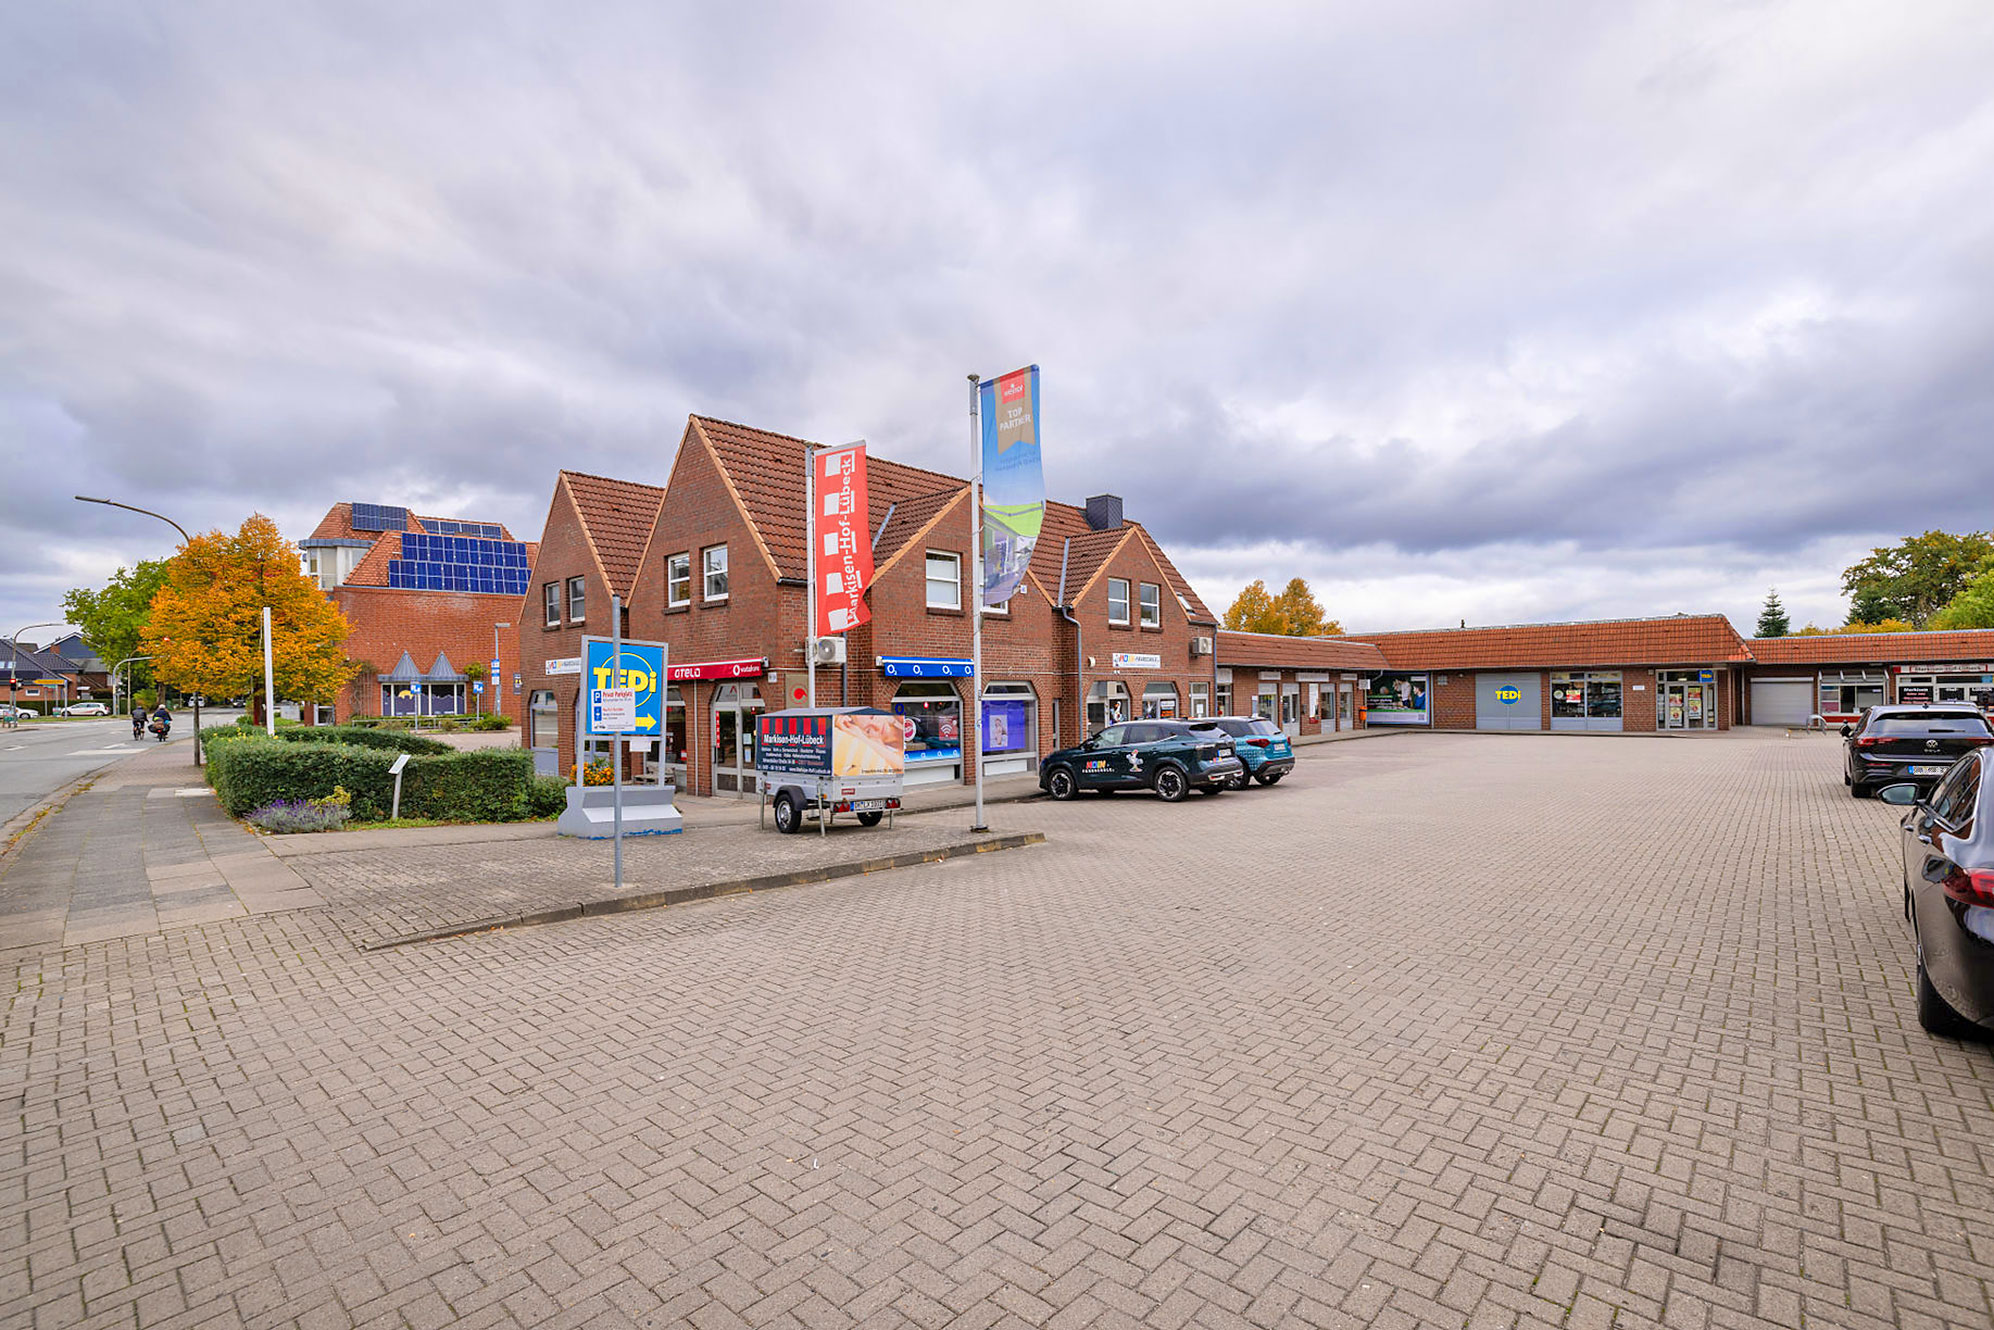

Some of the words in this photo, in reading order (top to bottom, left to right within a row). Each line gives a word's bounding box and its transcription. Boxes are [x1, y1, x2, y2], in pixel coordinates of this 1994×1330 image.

[1007, 407, 1022, 419] TOP
[593, 667, 657, 693] TEDi
[763, 734, 825, 745] Markisen-Hof-Lübeck
